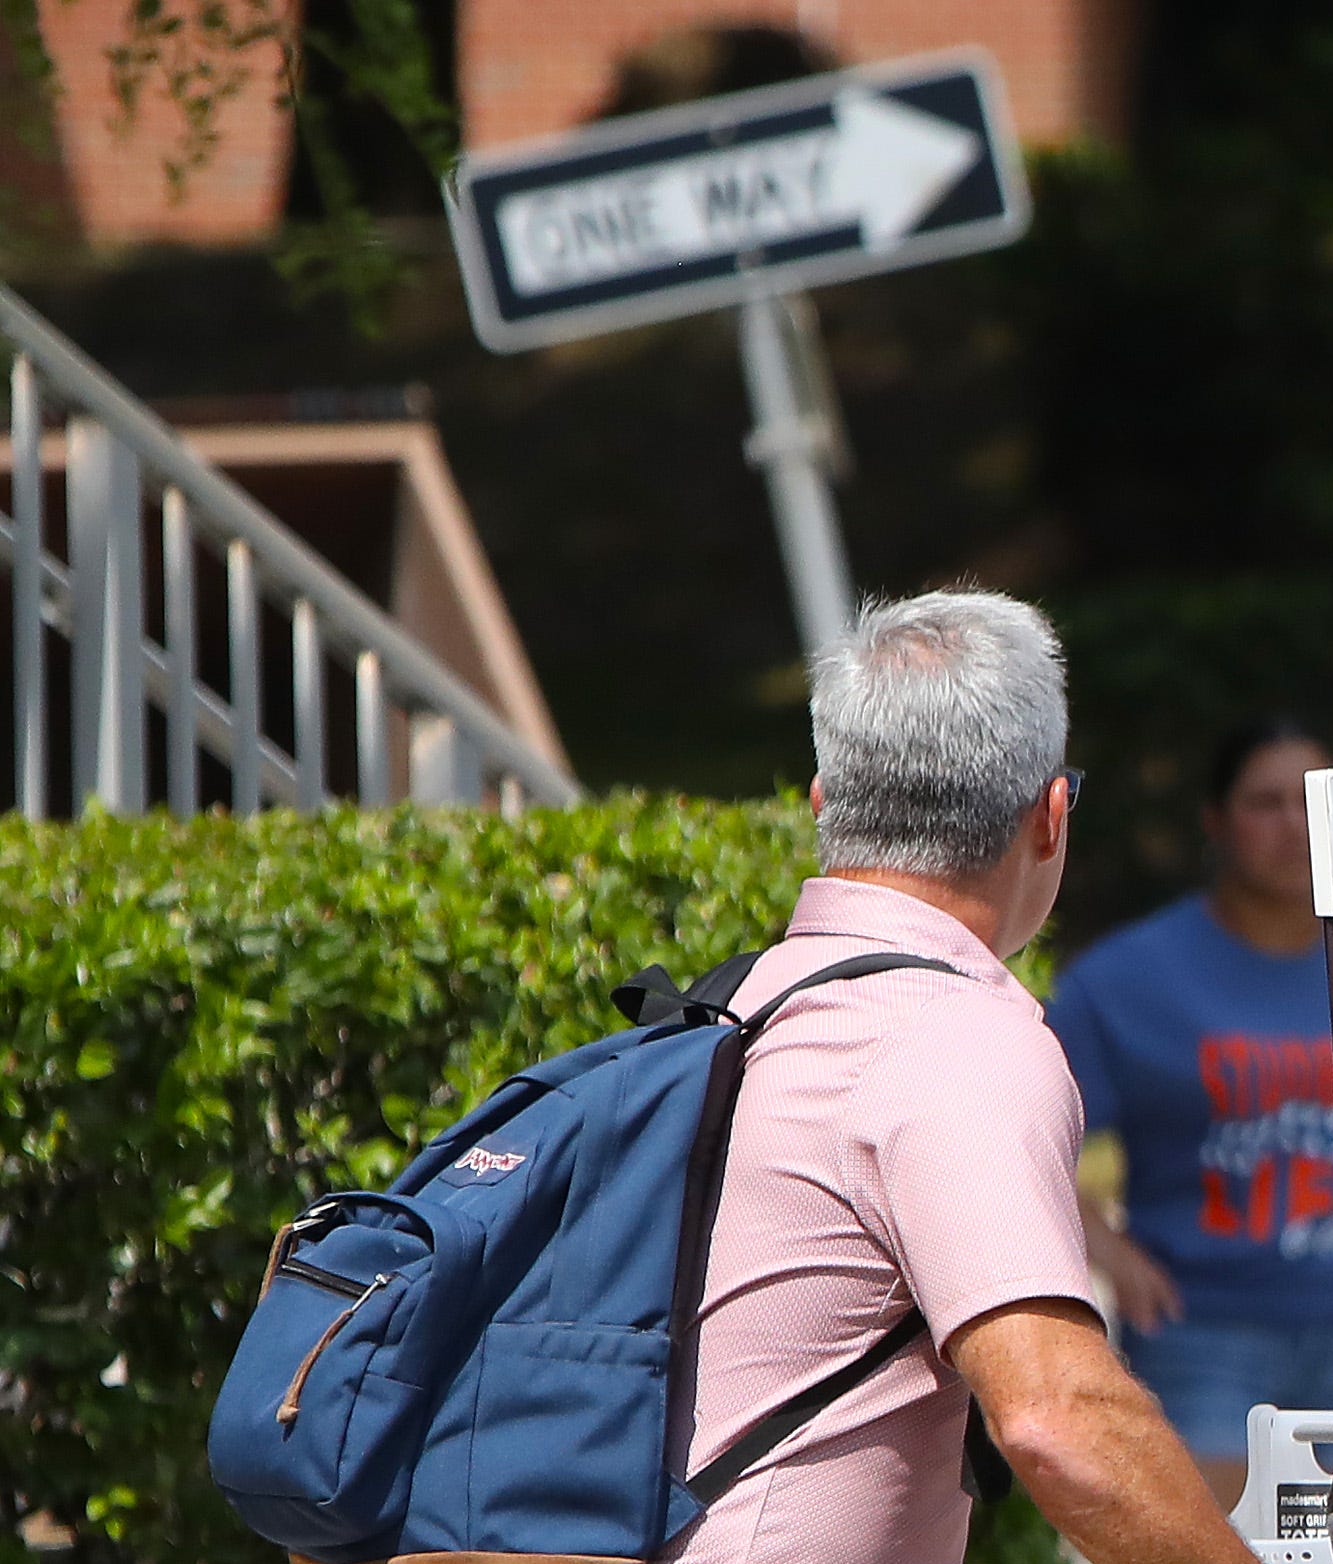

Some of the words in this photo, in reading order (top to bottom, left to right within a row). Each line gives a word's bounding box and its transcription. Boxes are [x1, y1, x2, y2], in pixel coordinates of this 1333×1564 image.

[526, 187, 657, 264] ONE
[701, 152, 830, 226] WAY
[1280, 1515, 1304, 1528] SOFT
